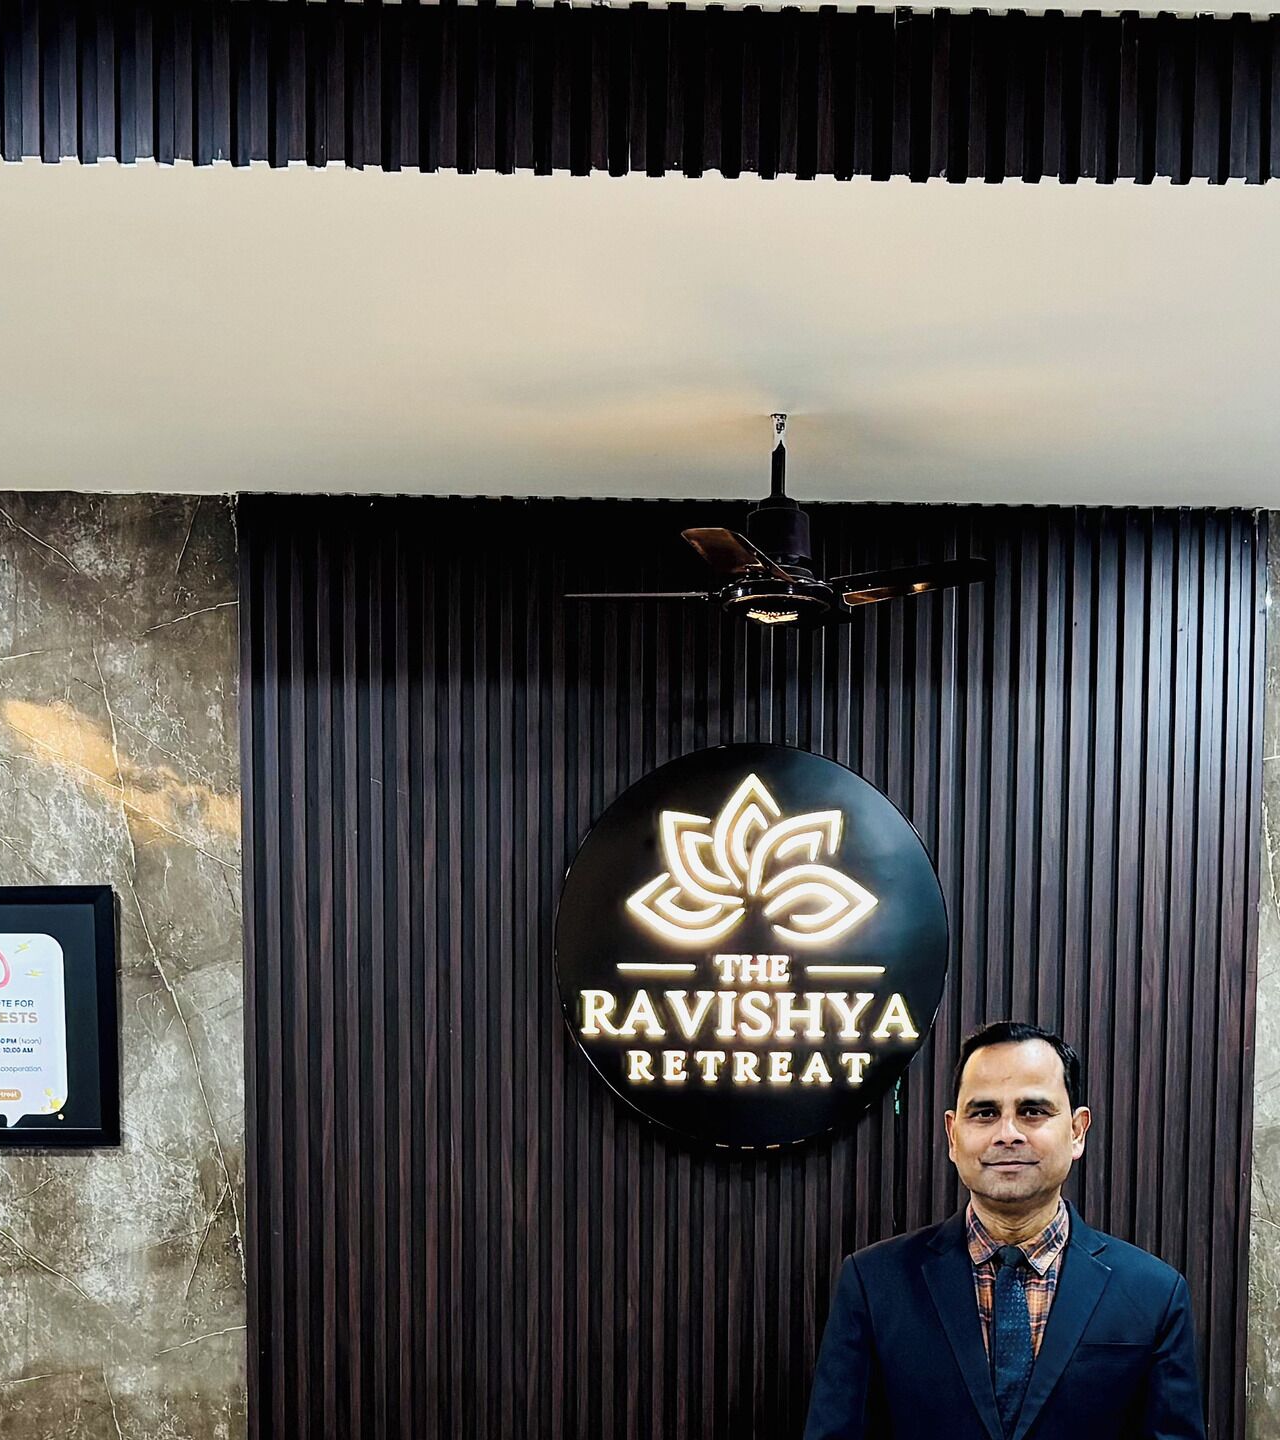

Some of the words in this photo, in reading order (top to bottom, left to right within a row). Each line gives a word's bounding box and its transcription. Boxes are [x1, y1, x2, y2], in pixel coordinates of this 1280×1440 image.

[714, 953, 791, 982] THE
[14, 1000, 34, 1008] FOR
[580, 989, 920, 1038] RAVISHYA
[6, 1037, 17, 1045] PM
[22, 1046, 34, 1054] AM
[628, 1050, 871, 1083] RETREAT
